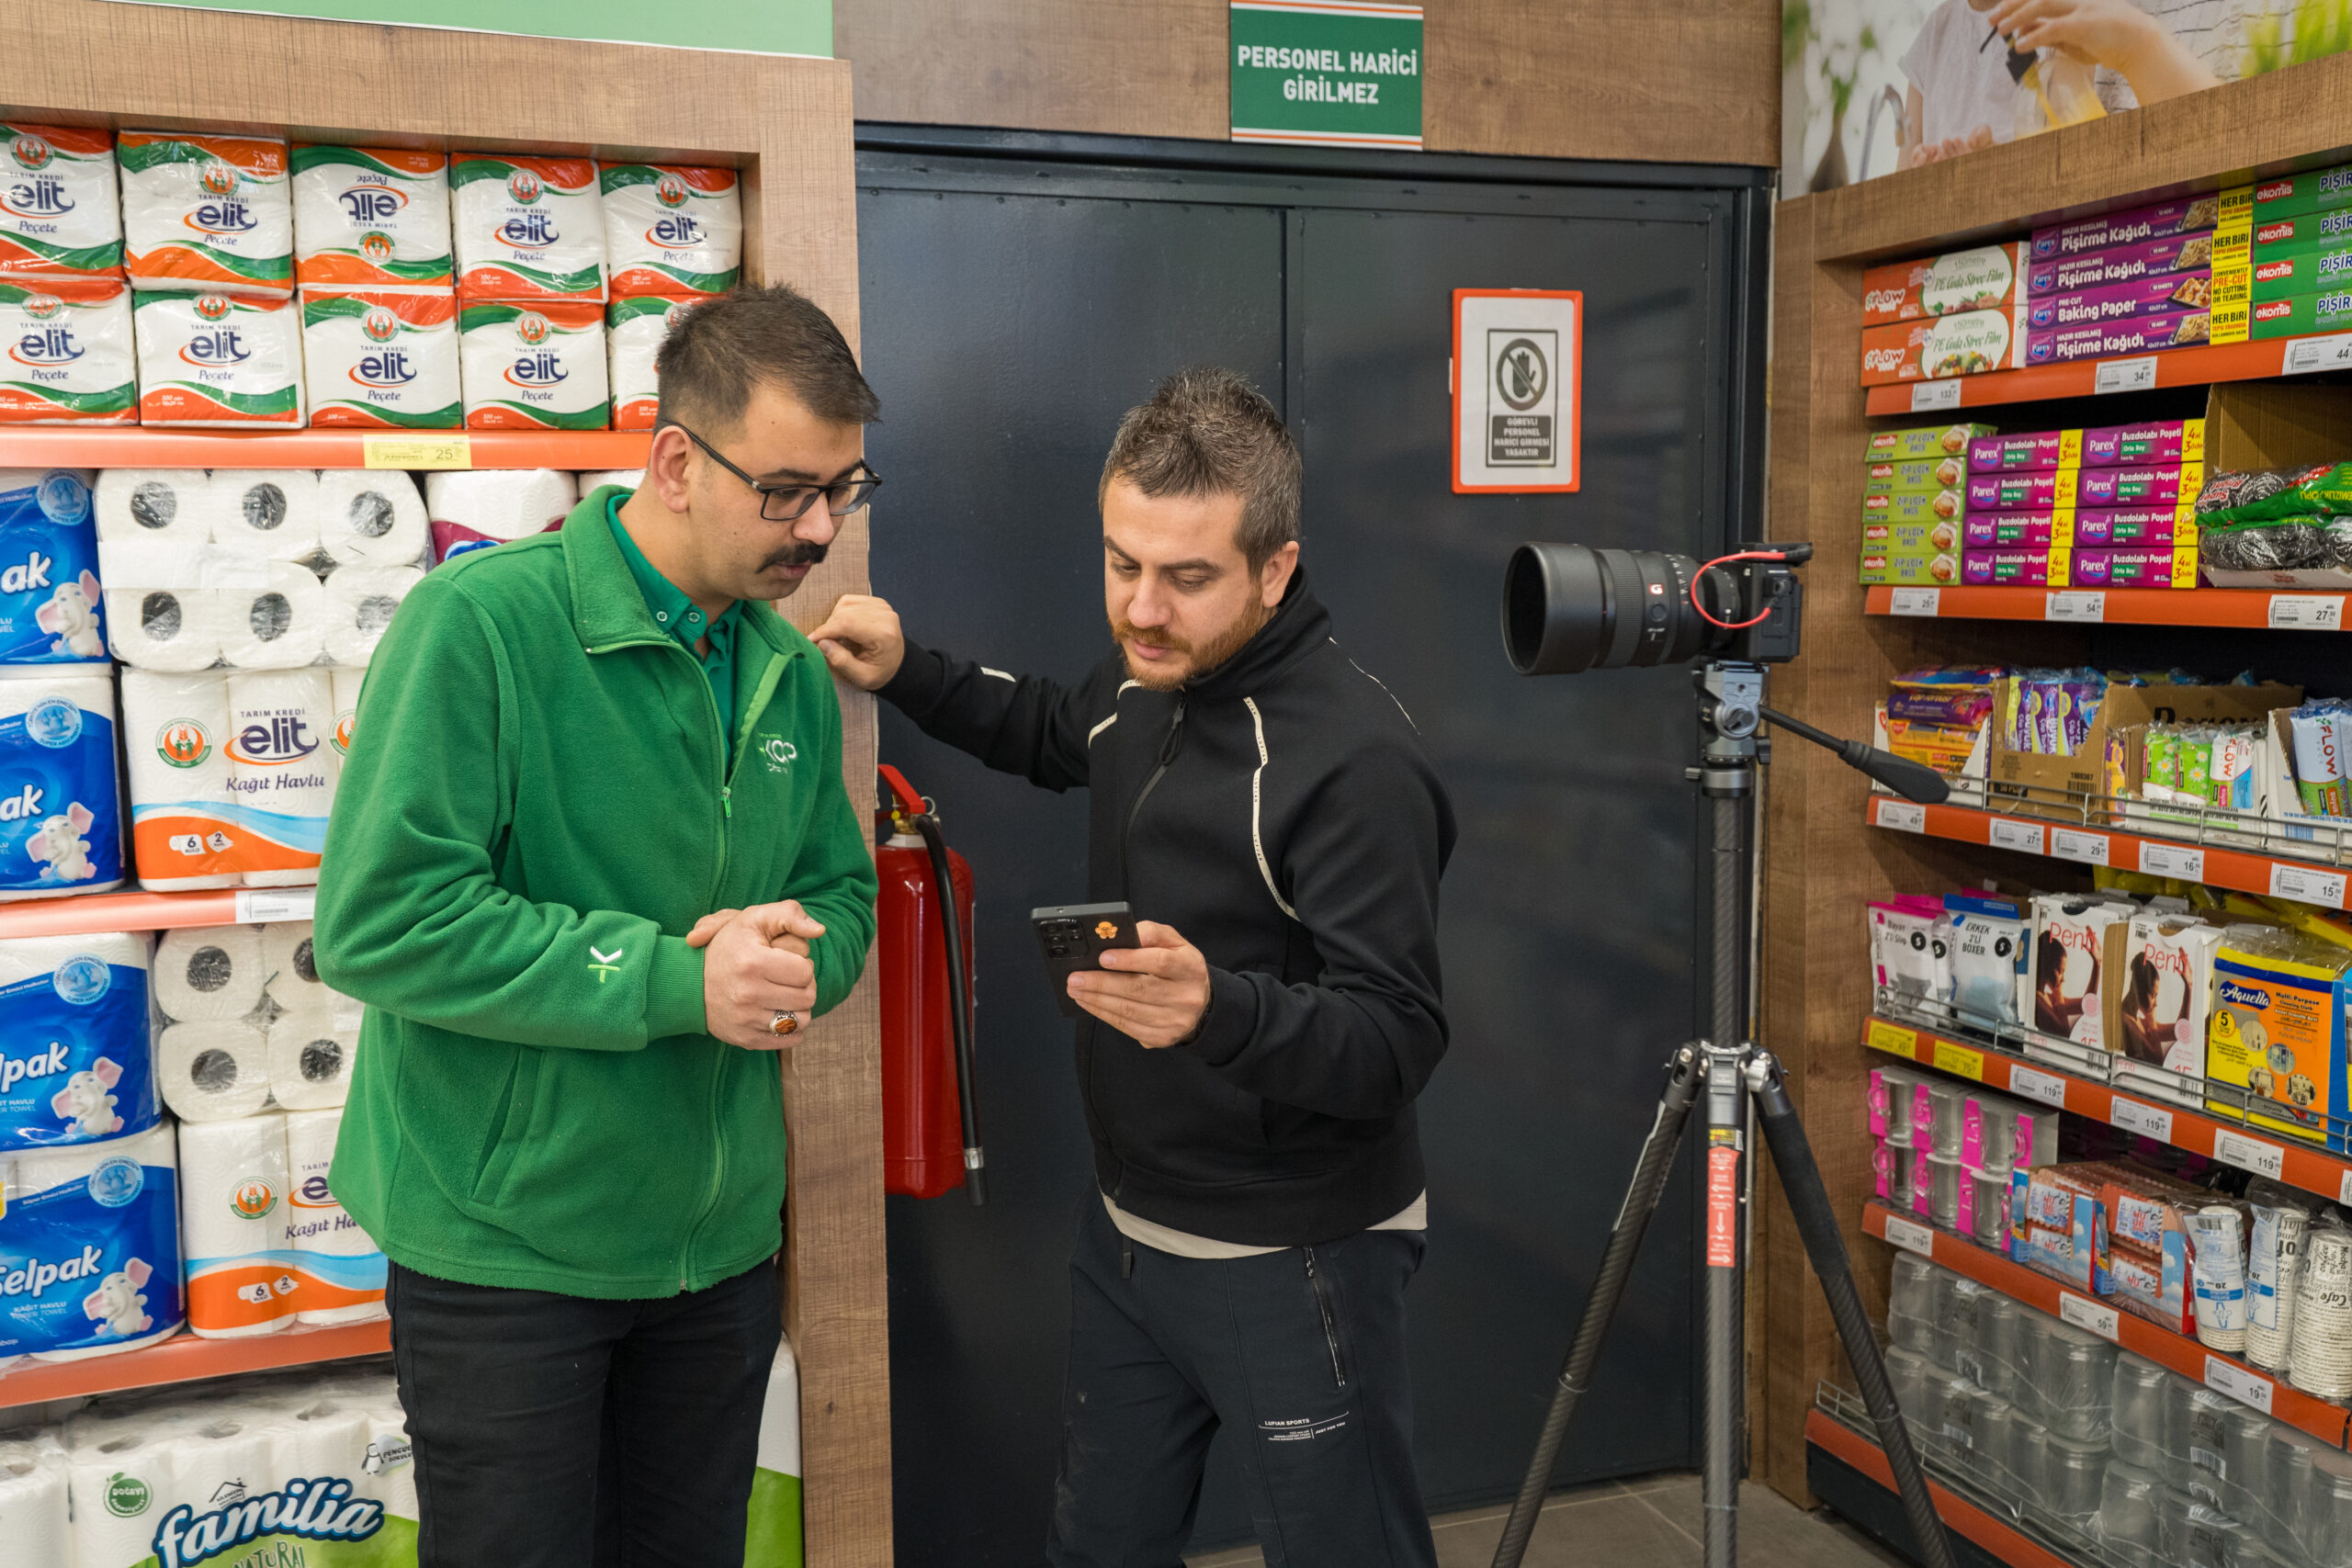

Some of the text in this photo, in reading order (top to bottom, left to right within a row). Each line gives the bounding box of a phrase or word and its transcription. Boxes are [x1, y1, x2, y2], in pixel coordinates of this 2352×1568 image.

[1238, 45, 1418, 76] PERSONEL HARİCİ
[1283, 73, 1379, 105] GİRİLMEZ
[9, 180, 75, 212] elit
[2256, 184, 2293, 201] ekomis
[339, 189, 398, 221] elit
[2221, 192, 2253, 209] HER BİR
[196, 202, 257, 231] elit
[18, 220, 58, 234] Peçete
[504, 214, 560, 243] elit
[655, 218, 707, 243] elit
[204, 233, 238, 245] Peçete
[2062, 221, 2151, 253] Pişirme Kağıdı
[2214, 231, 2249, 248] HER BİRİ
[2257, 226, 2293, 242] ekomis
[514, 251, 545, 262] Peçete
[1984, 270, 2004, 282] Film
[2058, 259, 2146, 289] Pişirme Kağıdı
[2256, 264, 2292, 280] ekomis
[2213, 274, 2247, 287] PRE-CUT
[2222, 284, 2247, 294] CUTTING
[1871, 288, 1905, 304] FLOW
[2222, 292, 2247, 302] TEARING
[2058, 299, 2136, 321] Baking Paper
[2256, 303, 2290, 319] ekomis
[2212, 310, 2247, 324] HER BİRİ
[20, 329, 85, 359] elit
[1984, 331, 2002, 345] Film
[190, 331, 252, 362] elit
[2056, 333, 2144, 359] Pişirme Kağıdı
[1871, 348, 1905, 364] FLOW
[2336, 348, 2349, 359] 44
[359, 353, 417, 382] elit
[514, 354, 569, 381] elit
[31, 369, 70, 382] Peçete
[198, 369, 235, 381] Peçete
[2134, 371, 2144, 382] 34
[368, 390, 401, 401] Peçete
[522, 390, 554, 401] Peçete
[1503, 427, 1541, 436] PERSONEL
[2121, 427, 2182, 441] Buzdolabı Poşeti
[2004, 437, 2059, 450] Buzdolabı Poşeti
[2089, 437, 2114, 452] Parex
[2184, 440, 2192, 453] 3
[435, 448, 453, 460] 25
[1505, 447, 1539, 457] YASAKTIR
[1974, 448, 1998, 459] Parex
[2061, 450, 2067, 461] 3
[2119, 469, 2179, 482] Buzdolabı Poşeti
[2001, 478, 2054, 488] Buzdolabı Poşeti
[2086, 478, 2111, 493] Parex
[2180, 482, 2188, 495] 3
[1973, 486, 1996, 497] Parex
[2056, 490, 2063, 501] 3
[1997, 515, 2051, 526] Buzdolabı Poşeti
[2114, 512, 2174, 524] Buzdolabı Poşeti
[1969, 523, 1992, 535] Parex
[2082, 519, 2108, 533] Parex
[2175, 525, 2183, 538] 3
[2052, 528, 2059, 539] 3
[1967, 560, 1990, 571] Parex
[1996, 554, 2047, 565] Buzdolabı Poşeti
[2080, 557, 2106, 572] Parex
[2112, 554, 2172, 565] Buzdolabı Poşeti
[2049, 568, 2055, 578] 3
[2173, 568, 2181, 580] 3
[2086, 603, 2096, 613] 54
[2315, 611, 2328, 621] 27
[240, 708, 306, 718] TARIM KREDİ
[240, 716, 320, 756] elit
[2319, 725, 2337, 775] FLOW
[225, 773, 325, 794] Kağıt Havlu
[187, 832, 222, 849] 6 2
[2026, 835, 2035, 844] 27
[2091, 845, 2100, 855] 29
[2184, 862, 2194, 871] 16
[2322, 886, 2333, 897] 15
[1964, 921, 1992, 934] ERKEK
[1962, 942, 1985, 955] BOXER
[2219, 986, 2271, 1008] Aquella
[2220, 1011, 2229, 1027] 5
[2043, 1086, 2056, 1098] 119
[2145, 1118, 2160, 1132] 119
[301, 1161, 330, 1172] TARIM
[2257, 1156, 2274, 1170] 119
[285, 1219, 330, 1240] Kağıt
[254, 1277, 288, 1296] 6 2
[2320, 1291, 2347, 1306] Cafe
[2249, 1387, 2260, 1400] 19
[154, 1477, 384, 1568] familia
